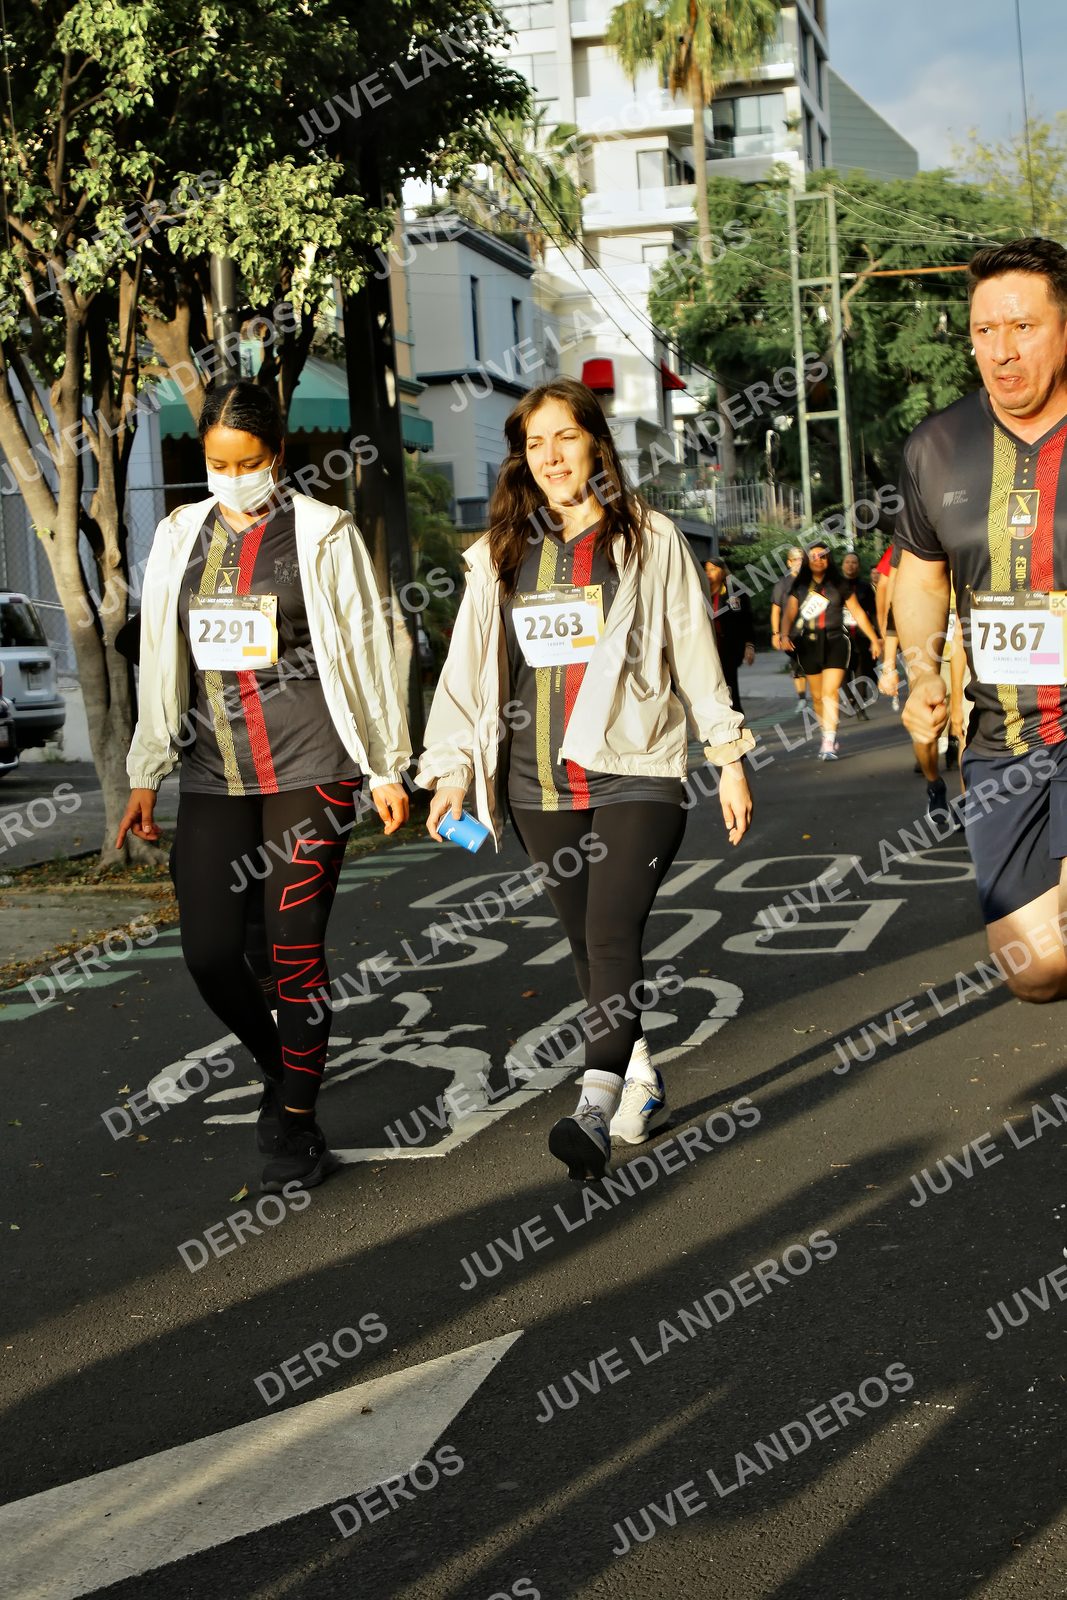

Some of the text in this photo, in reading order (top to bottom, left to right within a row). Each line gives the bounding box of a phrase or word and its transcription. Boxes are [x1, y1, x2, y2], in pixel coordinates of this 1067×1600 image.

[587, 591, 599, 600] 5K
[1051, 598, 1066, 609] 5K
[199, 619, 254, 644] 2291
[524, 612, 583, 641] 2263
[978, 622, 1046, 651] 7367
